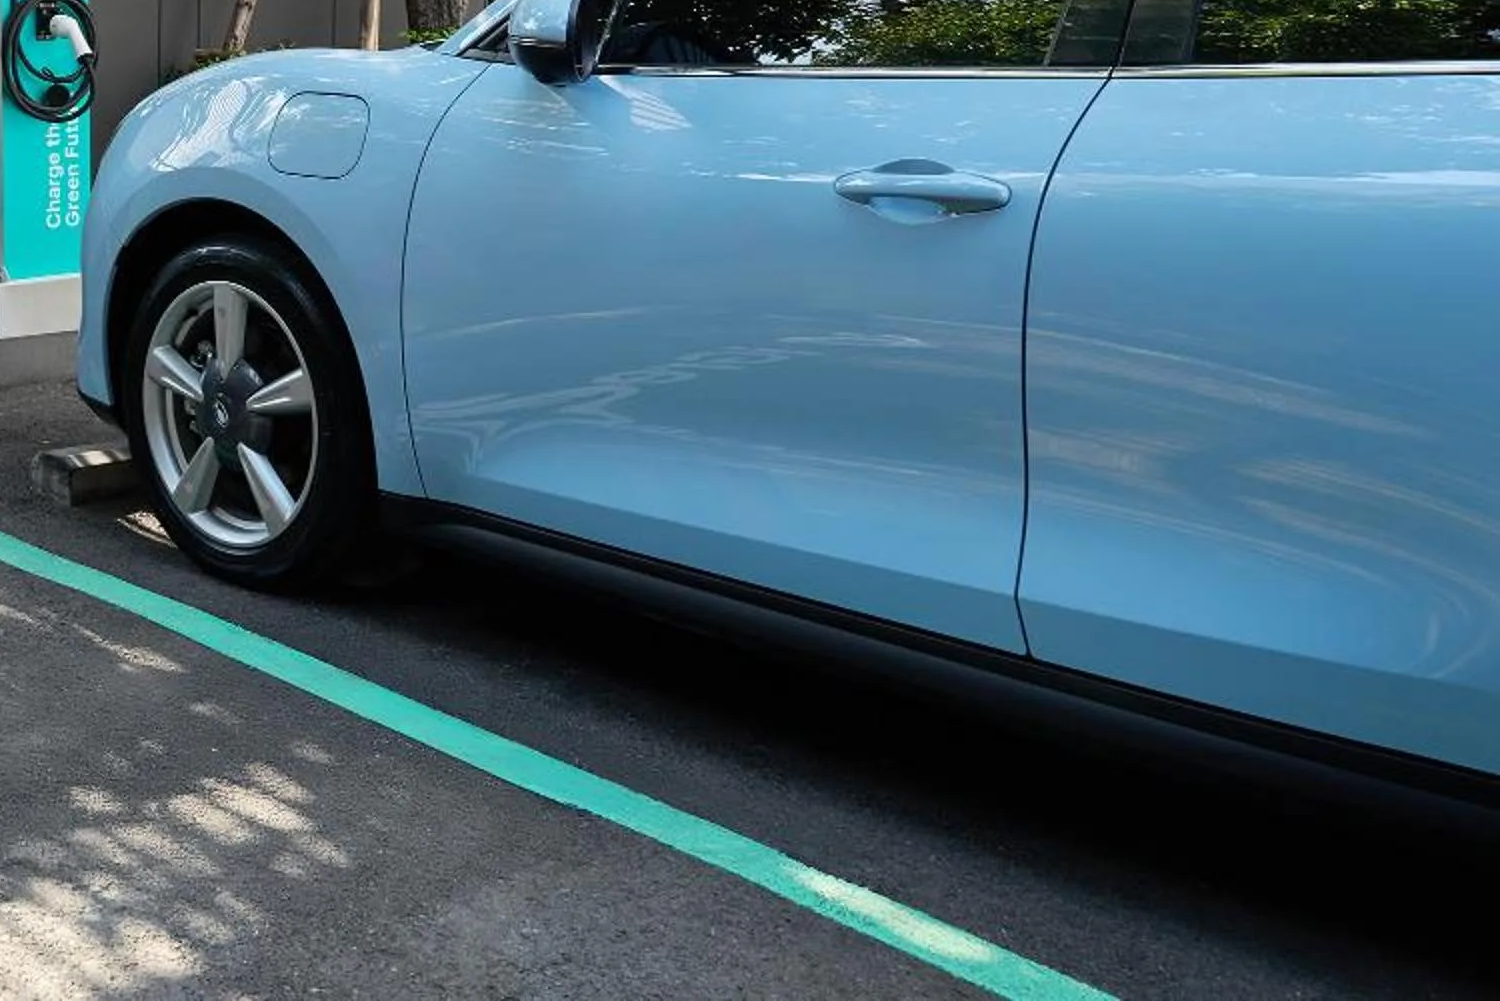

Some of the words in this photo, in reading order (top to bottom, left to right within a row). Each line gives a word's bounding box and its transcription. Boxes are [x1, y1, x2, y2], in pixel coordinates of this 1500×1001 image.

[45, 122, 61, 148] th
[45, 151, 65, 229] Charge
[65, 164, 81, 227] Green
